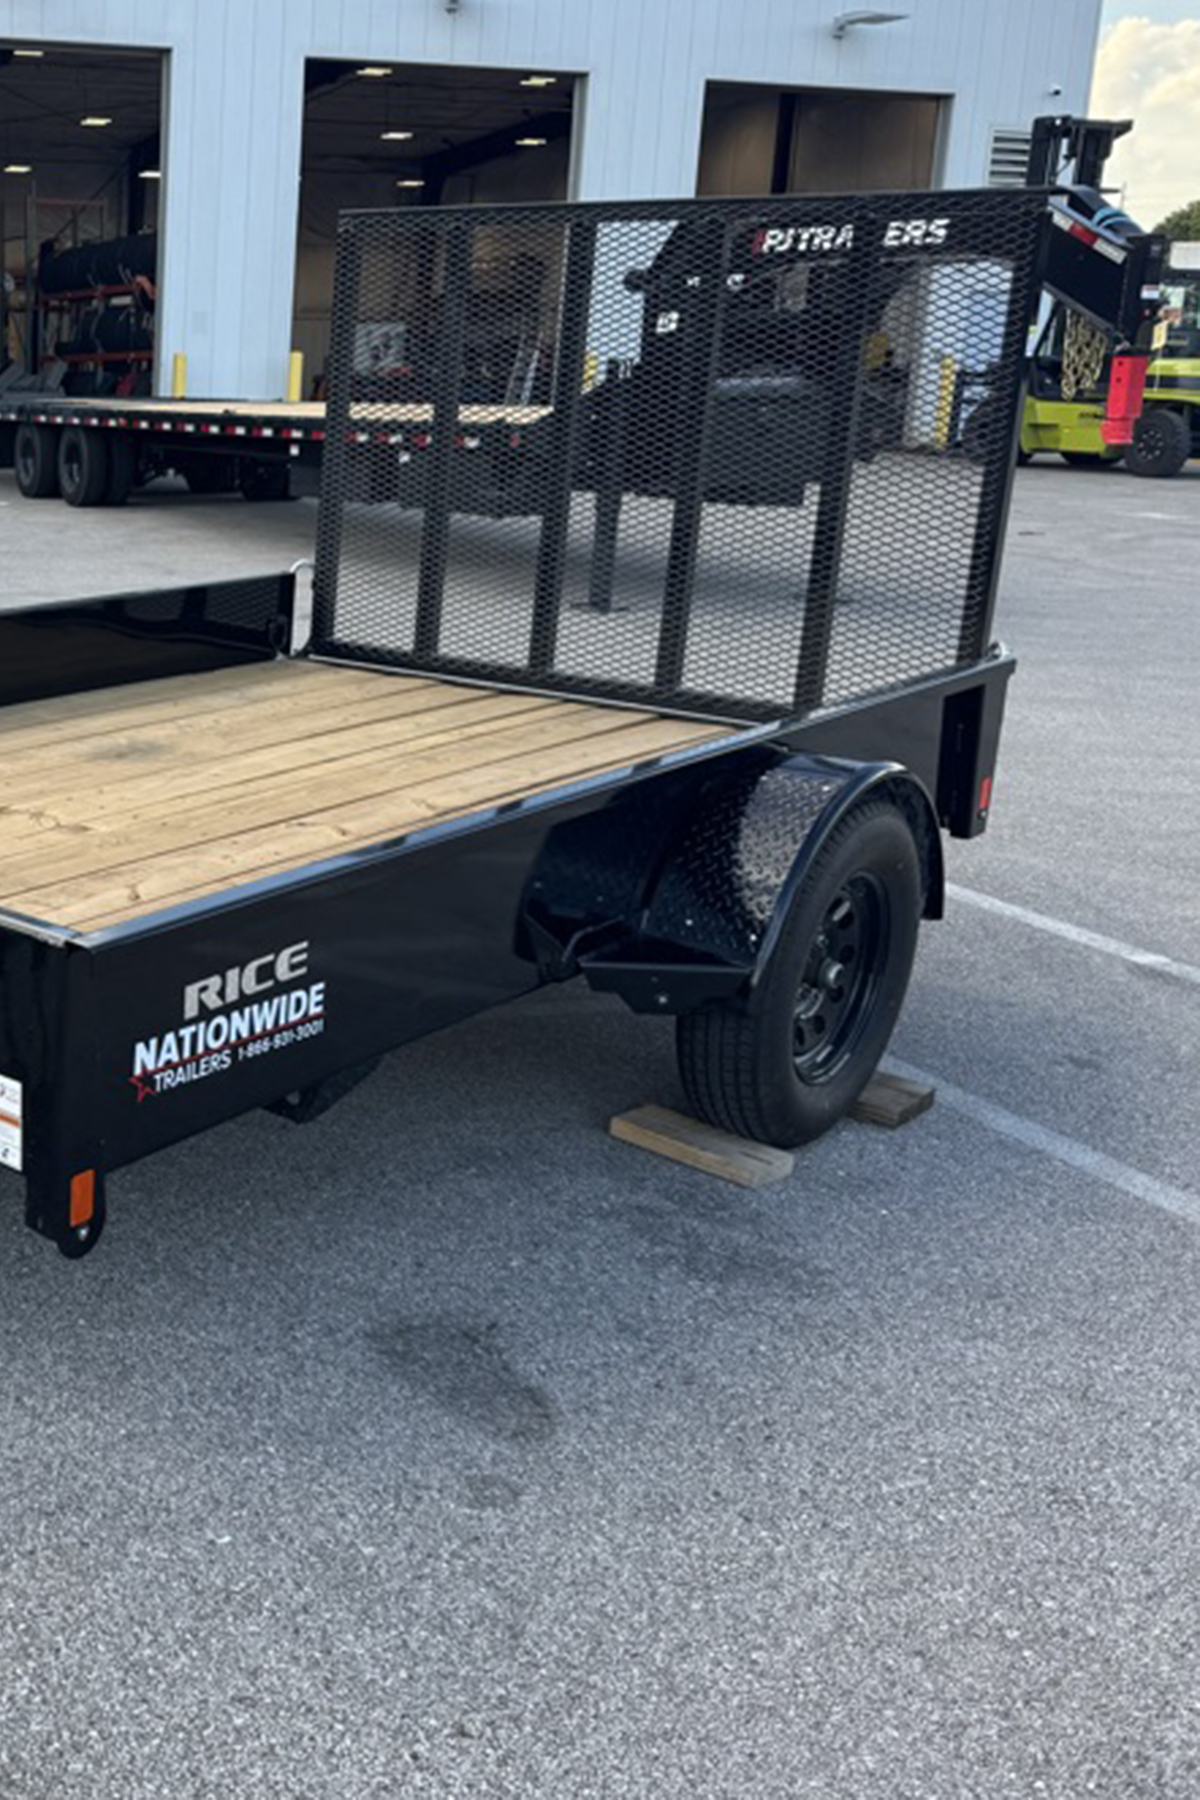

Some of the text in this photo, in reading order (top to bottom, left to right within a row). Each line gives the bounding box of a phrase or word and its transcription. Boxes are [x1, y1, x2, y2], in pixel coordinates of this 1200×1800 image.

[183, 941, 309, 1021] RICE
[133, 981, 326, 1077] NATIONWIDE
[153, 1049, 232, 1093] TRAILERS
